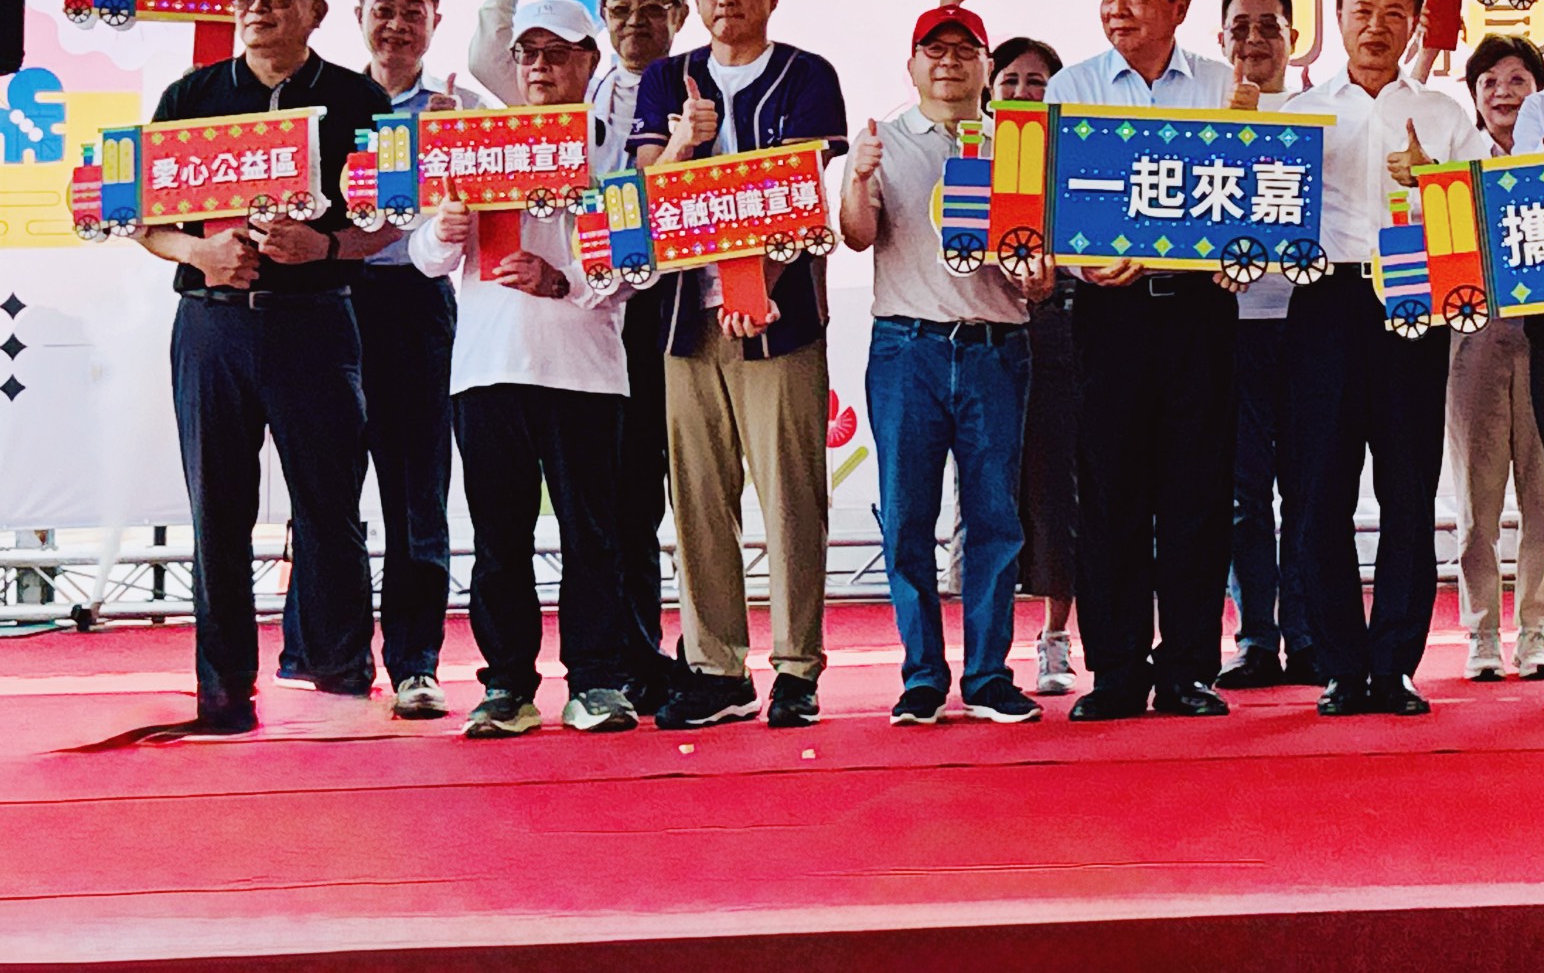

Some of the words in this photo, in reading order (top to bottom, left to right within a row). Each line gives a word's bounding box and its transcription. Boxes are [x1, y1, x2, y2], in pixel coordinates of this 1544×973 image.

[152, 147, 297, 189] 愛心公益區
[423, 141, 587, 178] 金融知識宣導
[655, 181, 818, 232] 金融知識宣導
[1068, 156, 1305, 224] 一起來嘉
